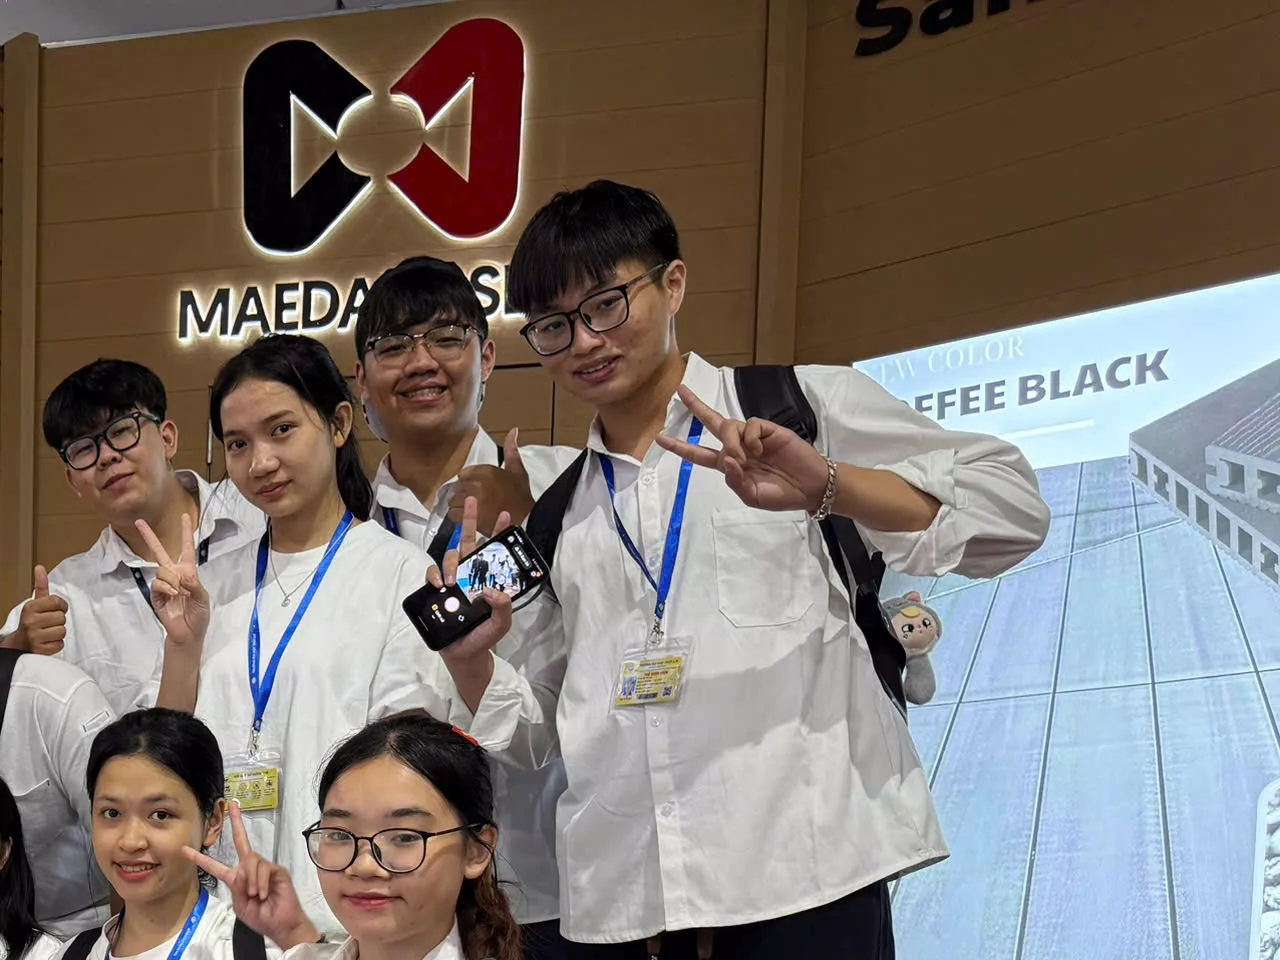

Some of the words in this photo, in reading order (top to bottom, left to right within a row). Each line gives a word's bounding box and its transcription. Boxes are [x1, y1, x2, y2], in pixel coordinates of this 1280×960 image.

[178, 276, 371, 341] MAEDA
[912, 379, 1007, 421] FFEE
[1017, 347, 1171, 406] BLACK
[927, 337, 1025, 375] COLOR
